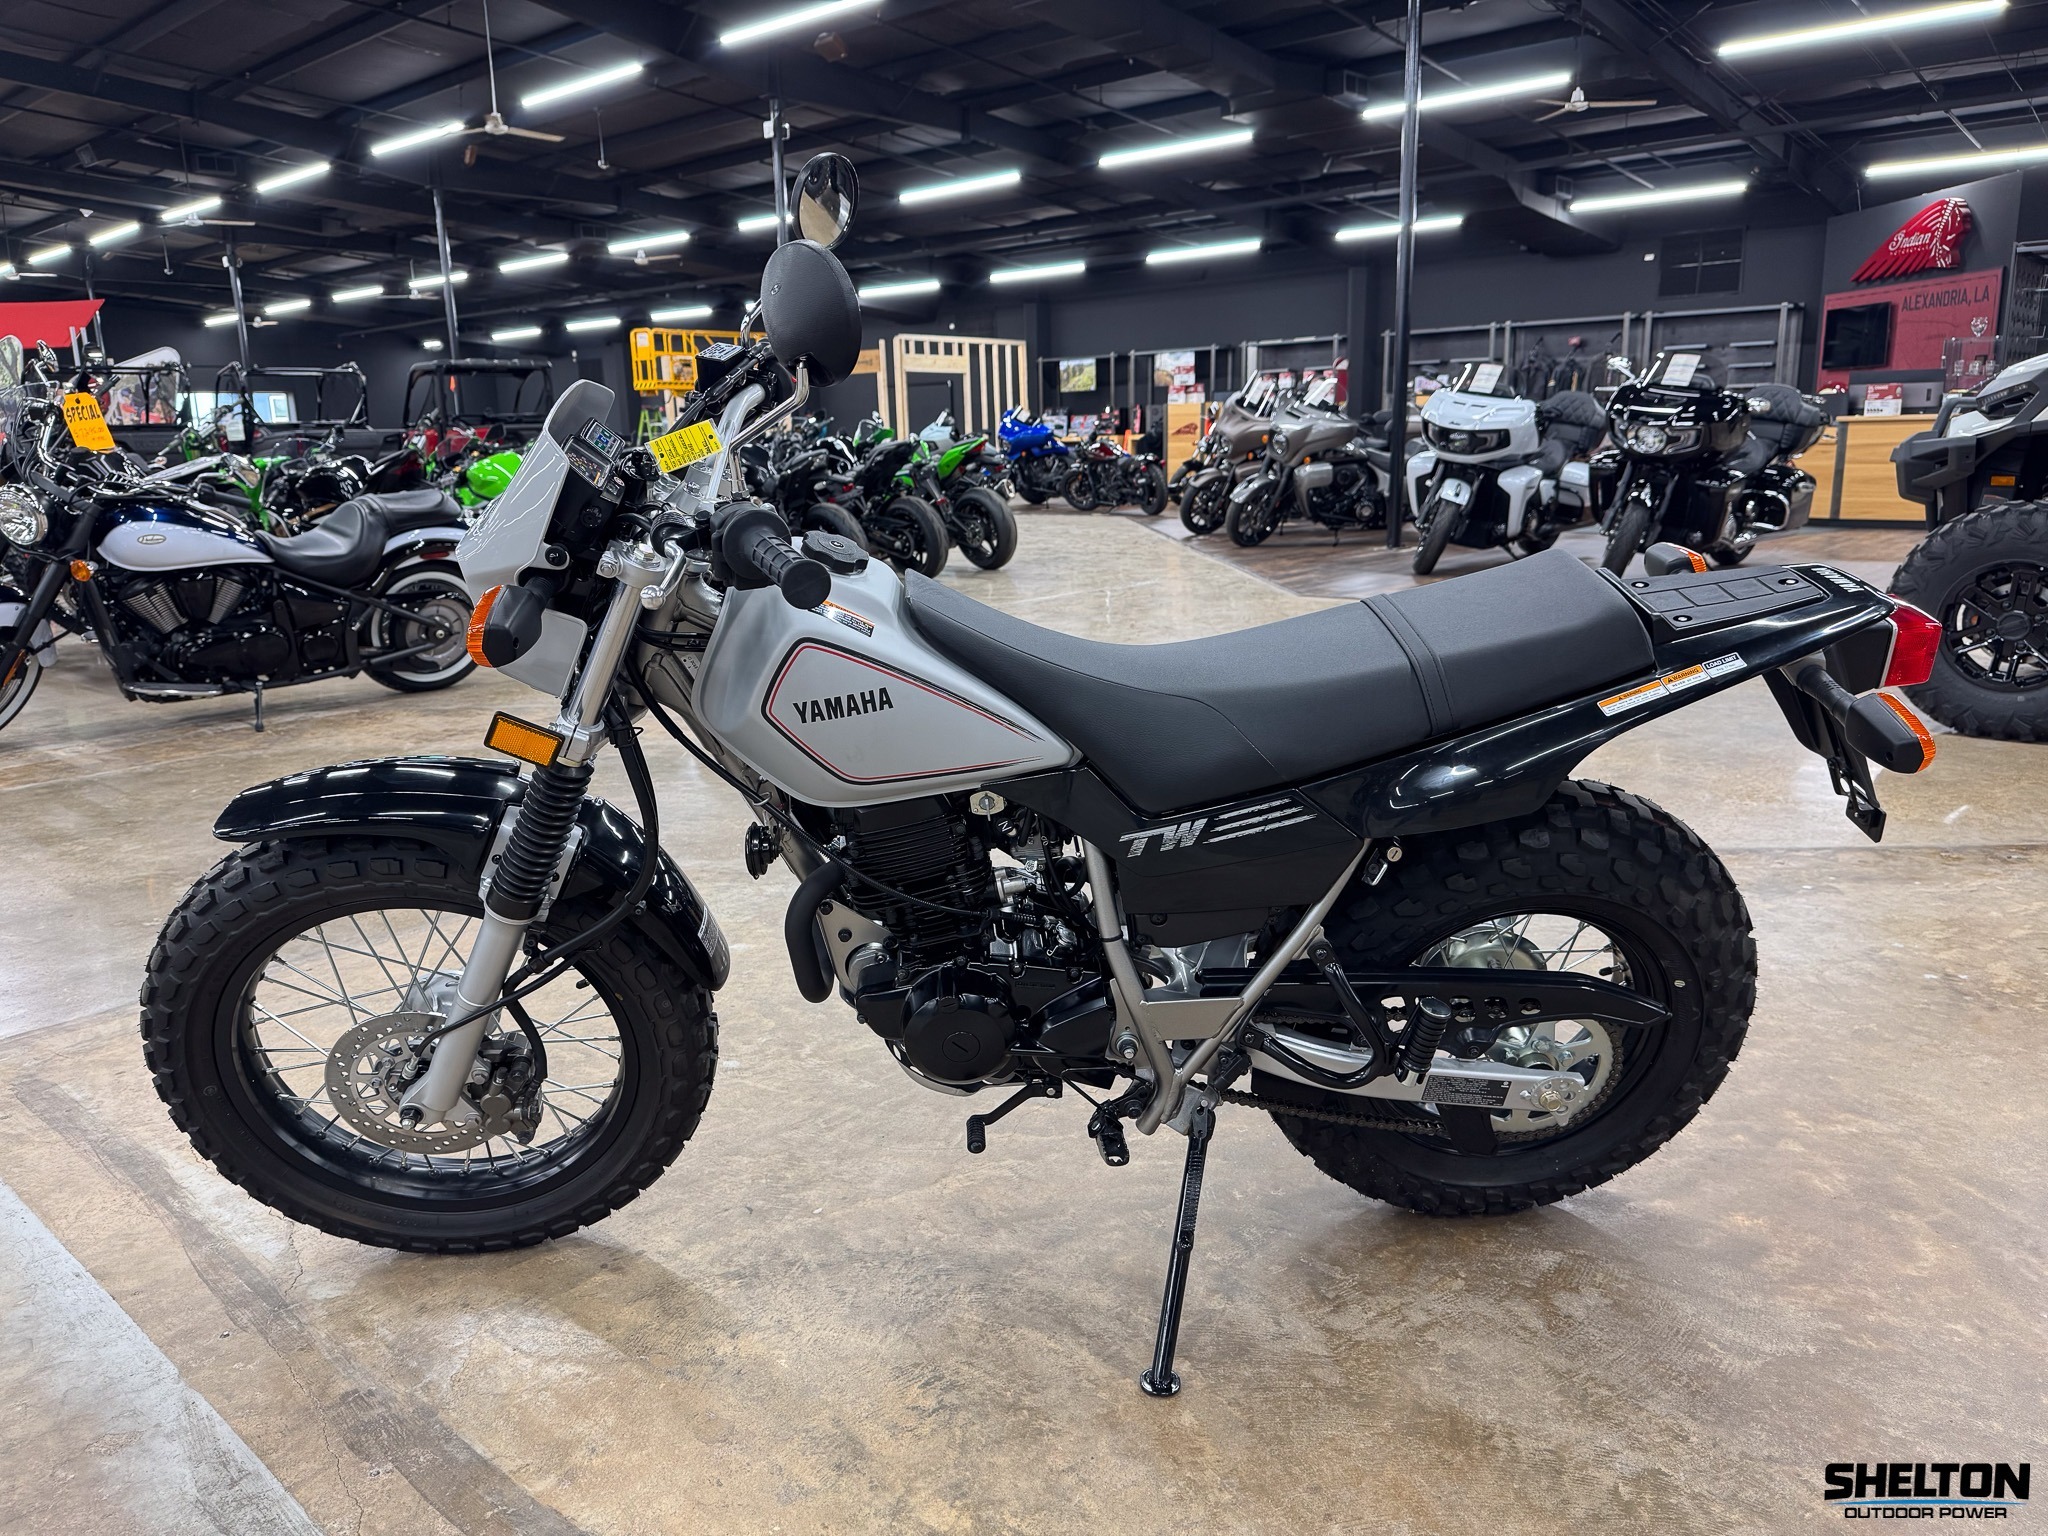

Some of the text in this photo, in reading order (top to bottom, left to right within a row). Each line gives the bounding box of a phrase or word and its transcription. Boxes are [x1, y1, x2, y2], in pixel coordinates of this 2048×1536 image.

[1888, 229, 1932, 251] Indian
[1901, 284, 1990, 313] ALEXANDRIA, LA
[66, 404, 100, 423] SPECIAL
[1811, 567, 1865, 593] YAMAHA
[1706, 659, 1722, 669] LOAD
[1722, 655, 1737, 664] LIMIT
[1672, 668, 1699, 681] WARNING
[792, 687, 894, 724] YAMAHA
[1119, 818, 1208, 858] TW
